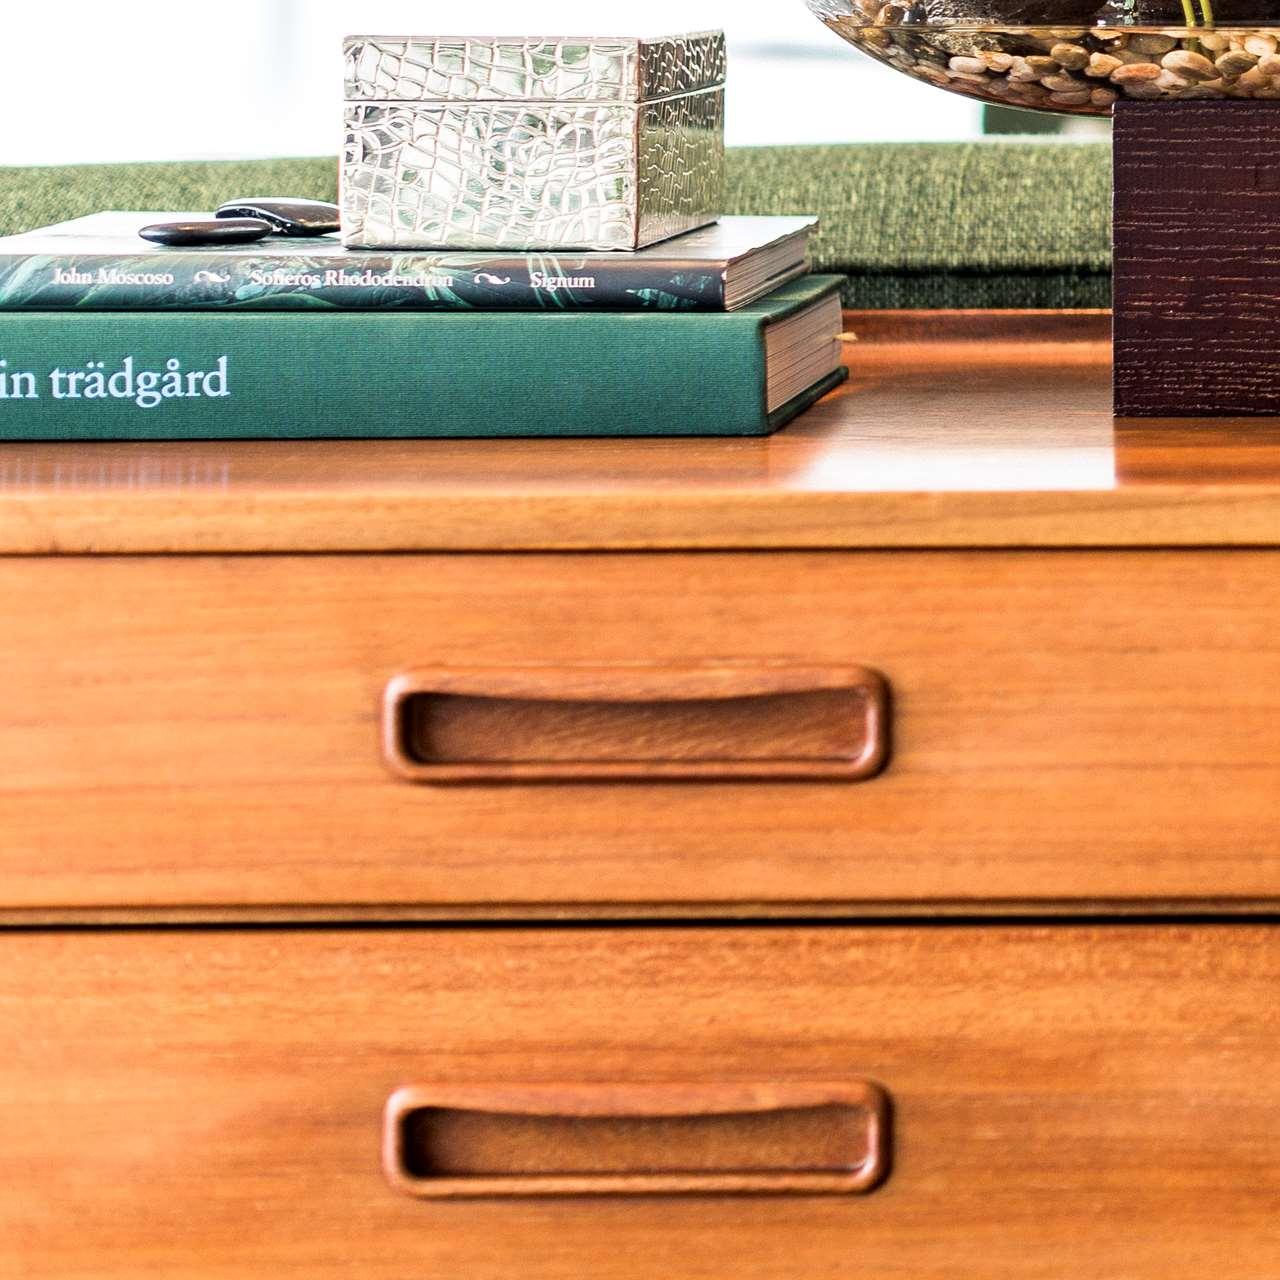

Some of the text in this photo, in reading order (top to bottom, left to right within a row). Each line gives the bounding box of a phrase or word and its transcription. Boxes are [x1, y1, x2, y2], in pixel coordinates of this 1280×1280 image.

[50, 267, 92, 285] John
[97, 267, 174, 285] Moscoso
[323, 268, 453, 287] Rhododendron
[530, 271, 595, 292] Signum
[49, 355, 231, 408] trädgård
